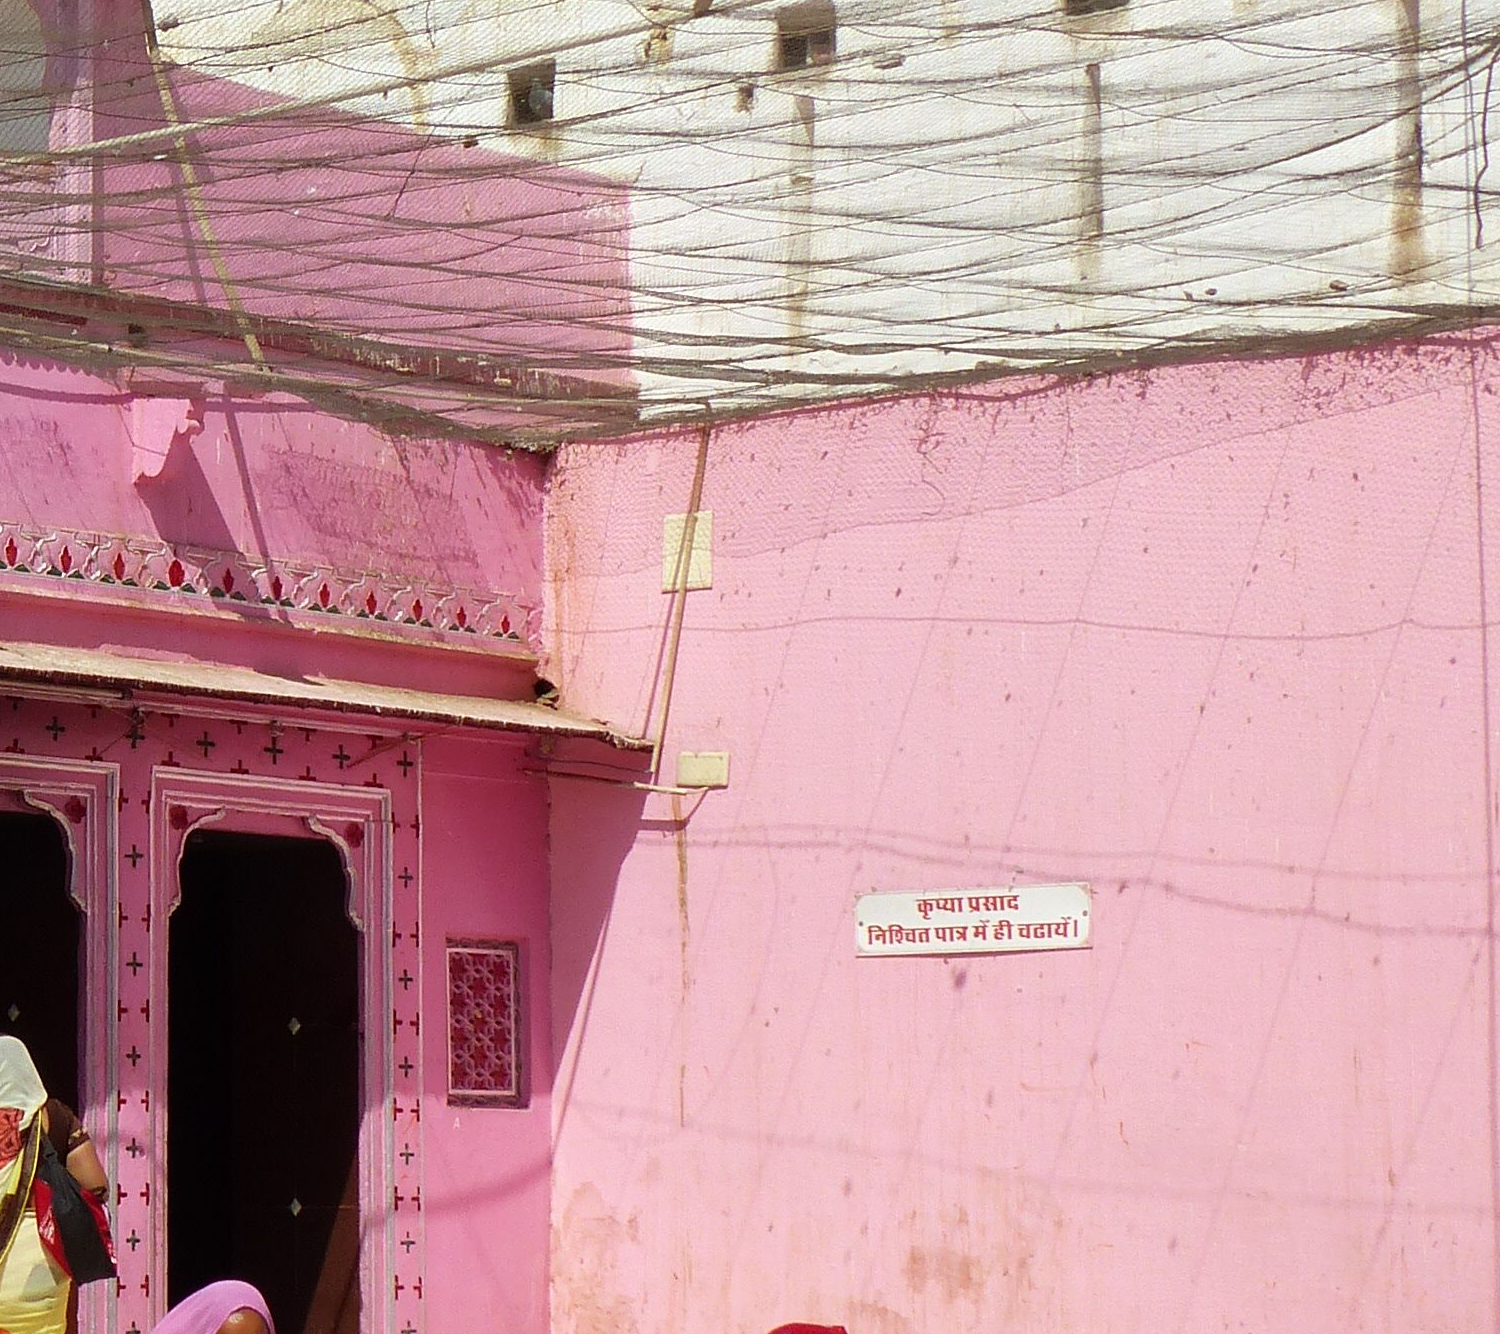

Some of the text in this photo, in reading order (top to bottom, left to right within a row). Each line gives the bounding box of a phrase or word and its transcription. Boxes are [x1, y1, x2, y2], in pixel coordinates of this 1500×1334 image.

[916, 895, 1020, 920] कृप्या प्रसाद
[934, 926, 968, 942] पात्र
[972, 919, 990, 941] में
[992, 920, 1013, 940] ही
